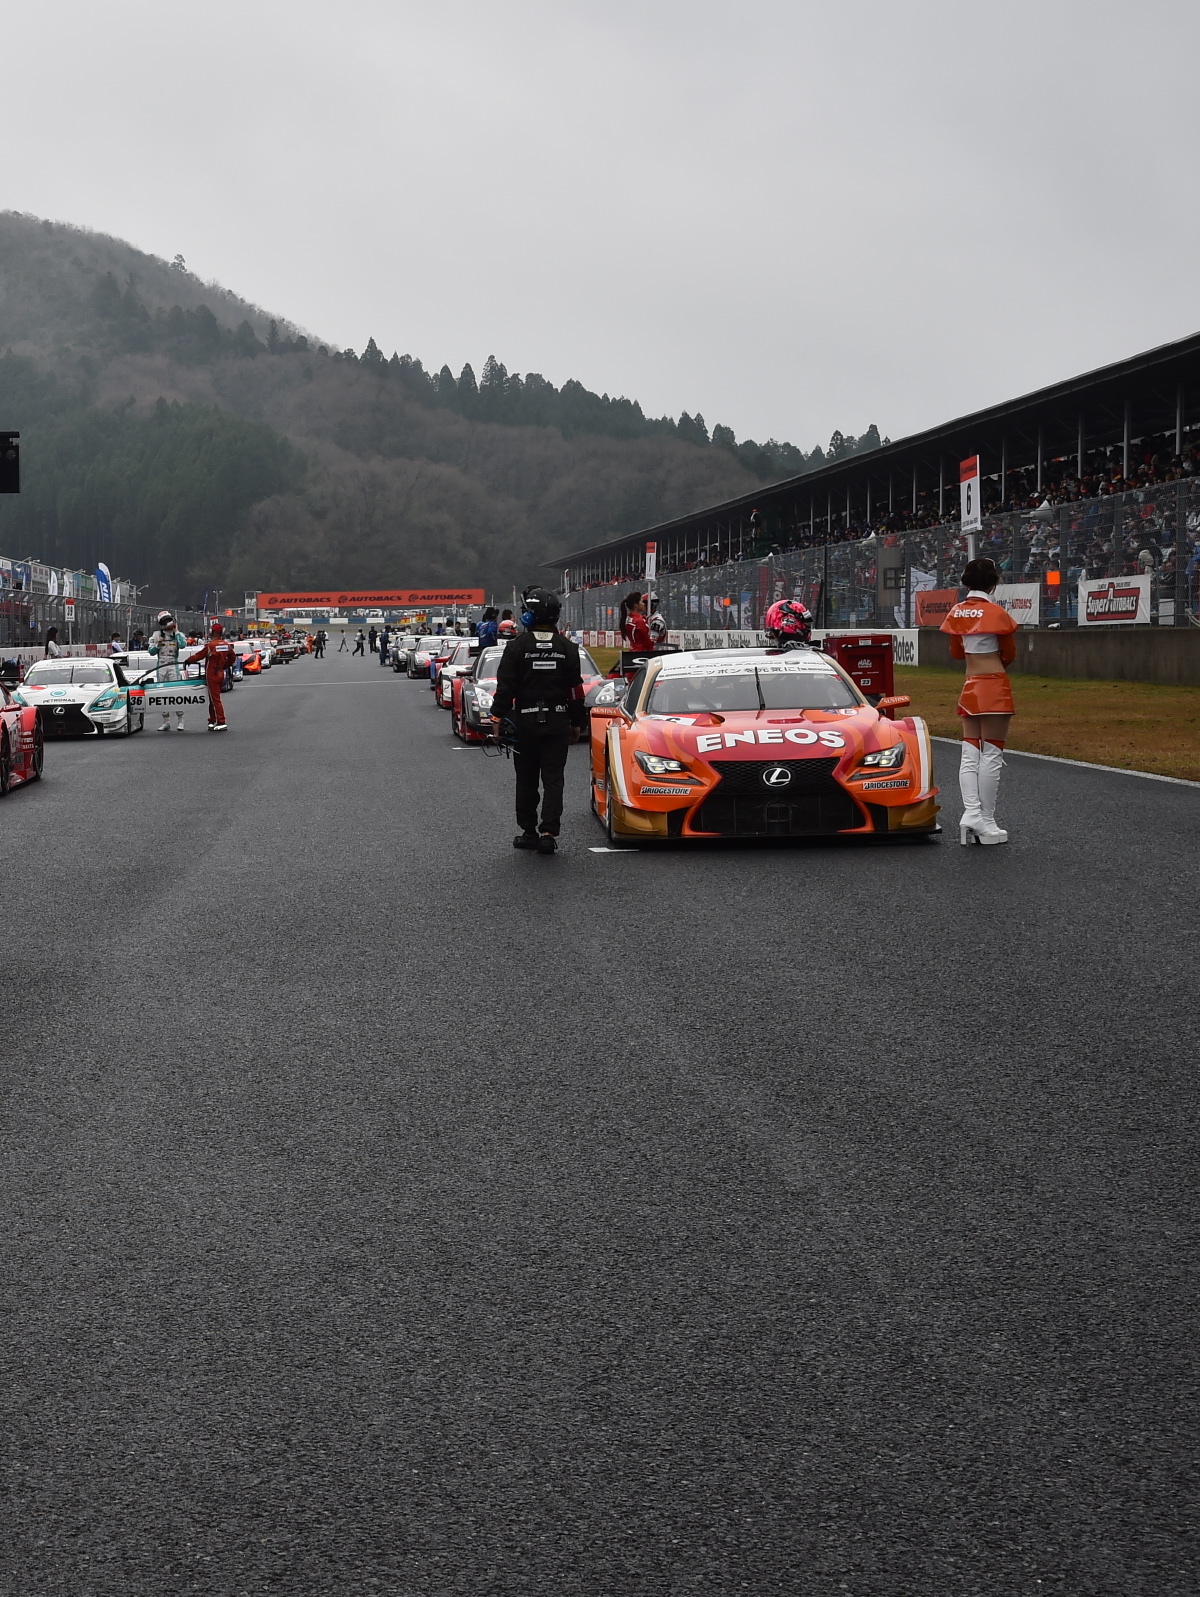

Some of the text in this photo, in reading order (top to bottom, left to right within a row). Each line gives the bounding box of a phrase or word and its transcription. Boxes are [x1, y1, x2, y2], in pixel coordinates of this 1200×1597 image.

[966, 483, 972, 515] 6
[420, 593, 473, 601] AUTOBACS
[954, 609, 984, 618] ENEOS
[894, 635, 915, 662] Rotec
[130, 696, 143, 706] 36
[148, 695, 206, 706] PETRONAS
[696, 728, 846, 754] ENEOS
[863, 780, 910, 790] BRIDGESTONE
[640, 787, 692, 795] BRIDGESTONE
